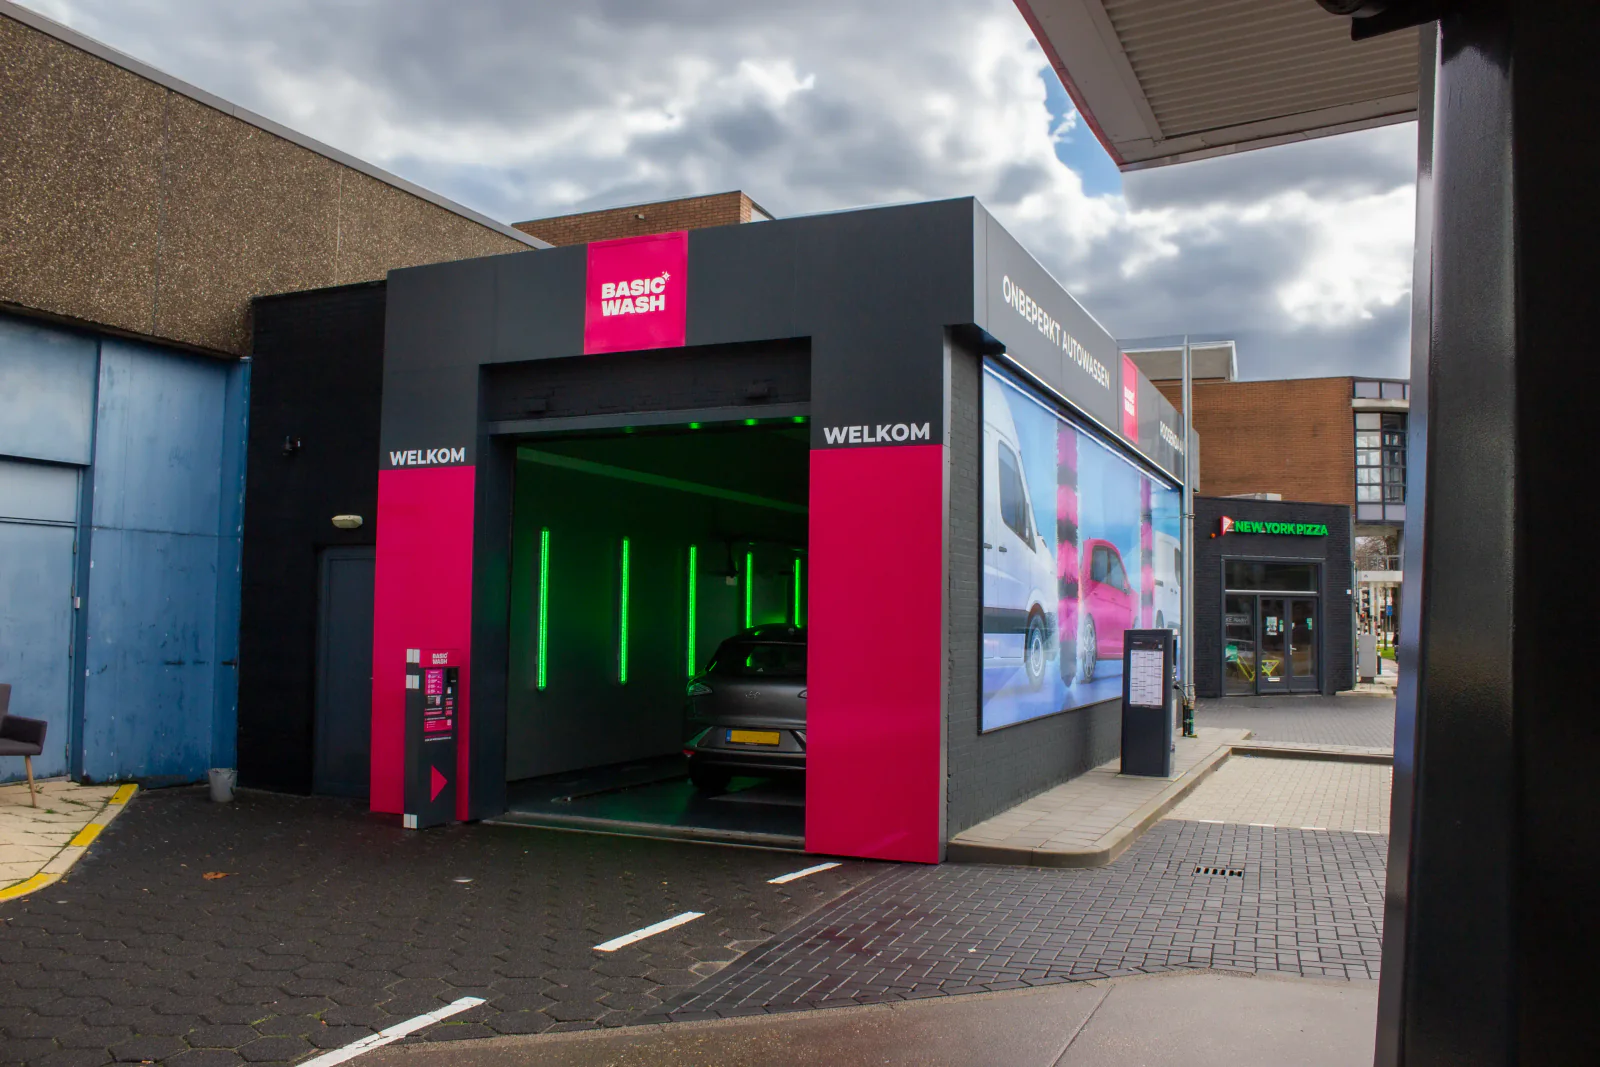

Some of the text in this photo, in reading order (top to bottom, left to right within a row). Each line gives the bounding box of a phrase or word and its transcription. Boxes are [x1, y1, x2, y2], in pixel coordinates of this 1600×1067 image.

[601, 276, 666, 299] BASIC
[601, 294, 666, 317] WASH
[1002, 274, 1110, 391] ONBEPERKT AUTOWASSEN
[823, 422, 930, 445] WELKOM
[389, 446, 466, 466] WELKOM
[1235, 520, 1329, 536] NEW YORK PIZZA
